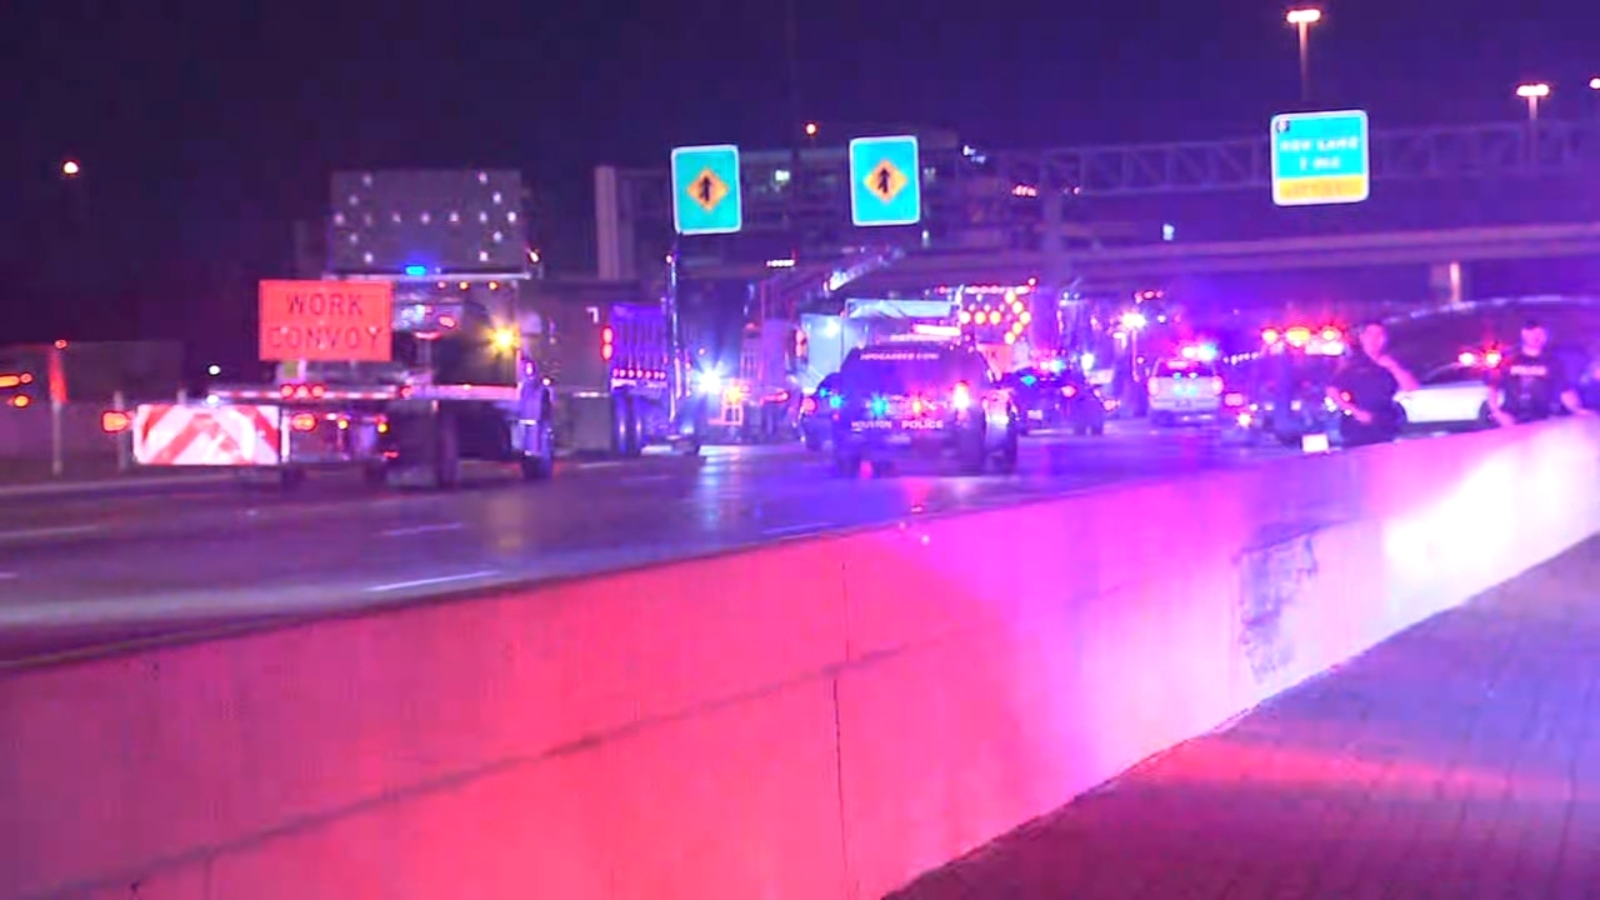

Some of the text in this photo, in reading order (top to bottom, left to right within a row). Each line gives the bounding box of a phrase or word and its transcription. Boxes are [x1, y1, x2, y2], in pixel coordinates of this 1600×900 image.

[287, 293, 362, 315] WORK
[269, 326, 381, 349] CONVOY
[901, 420, 943, 430] POLICE
